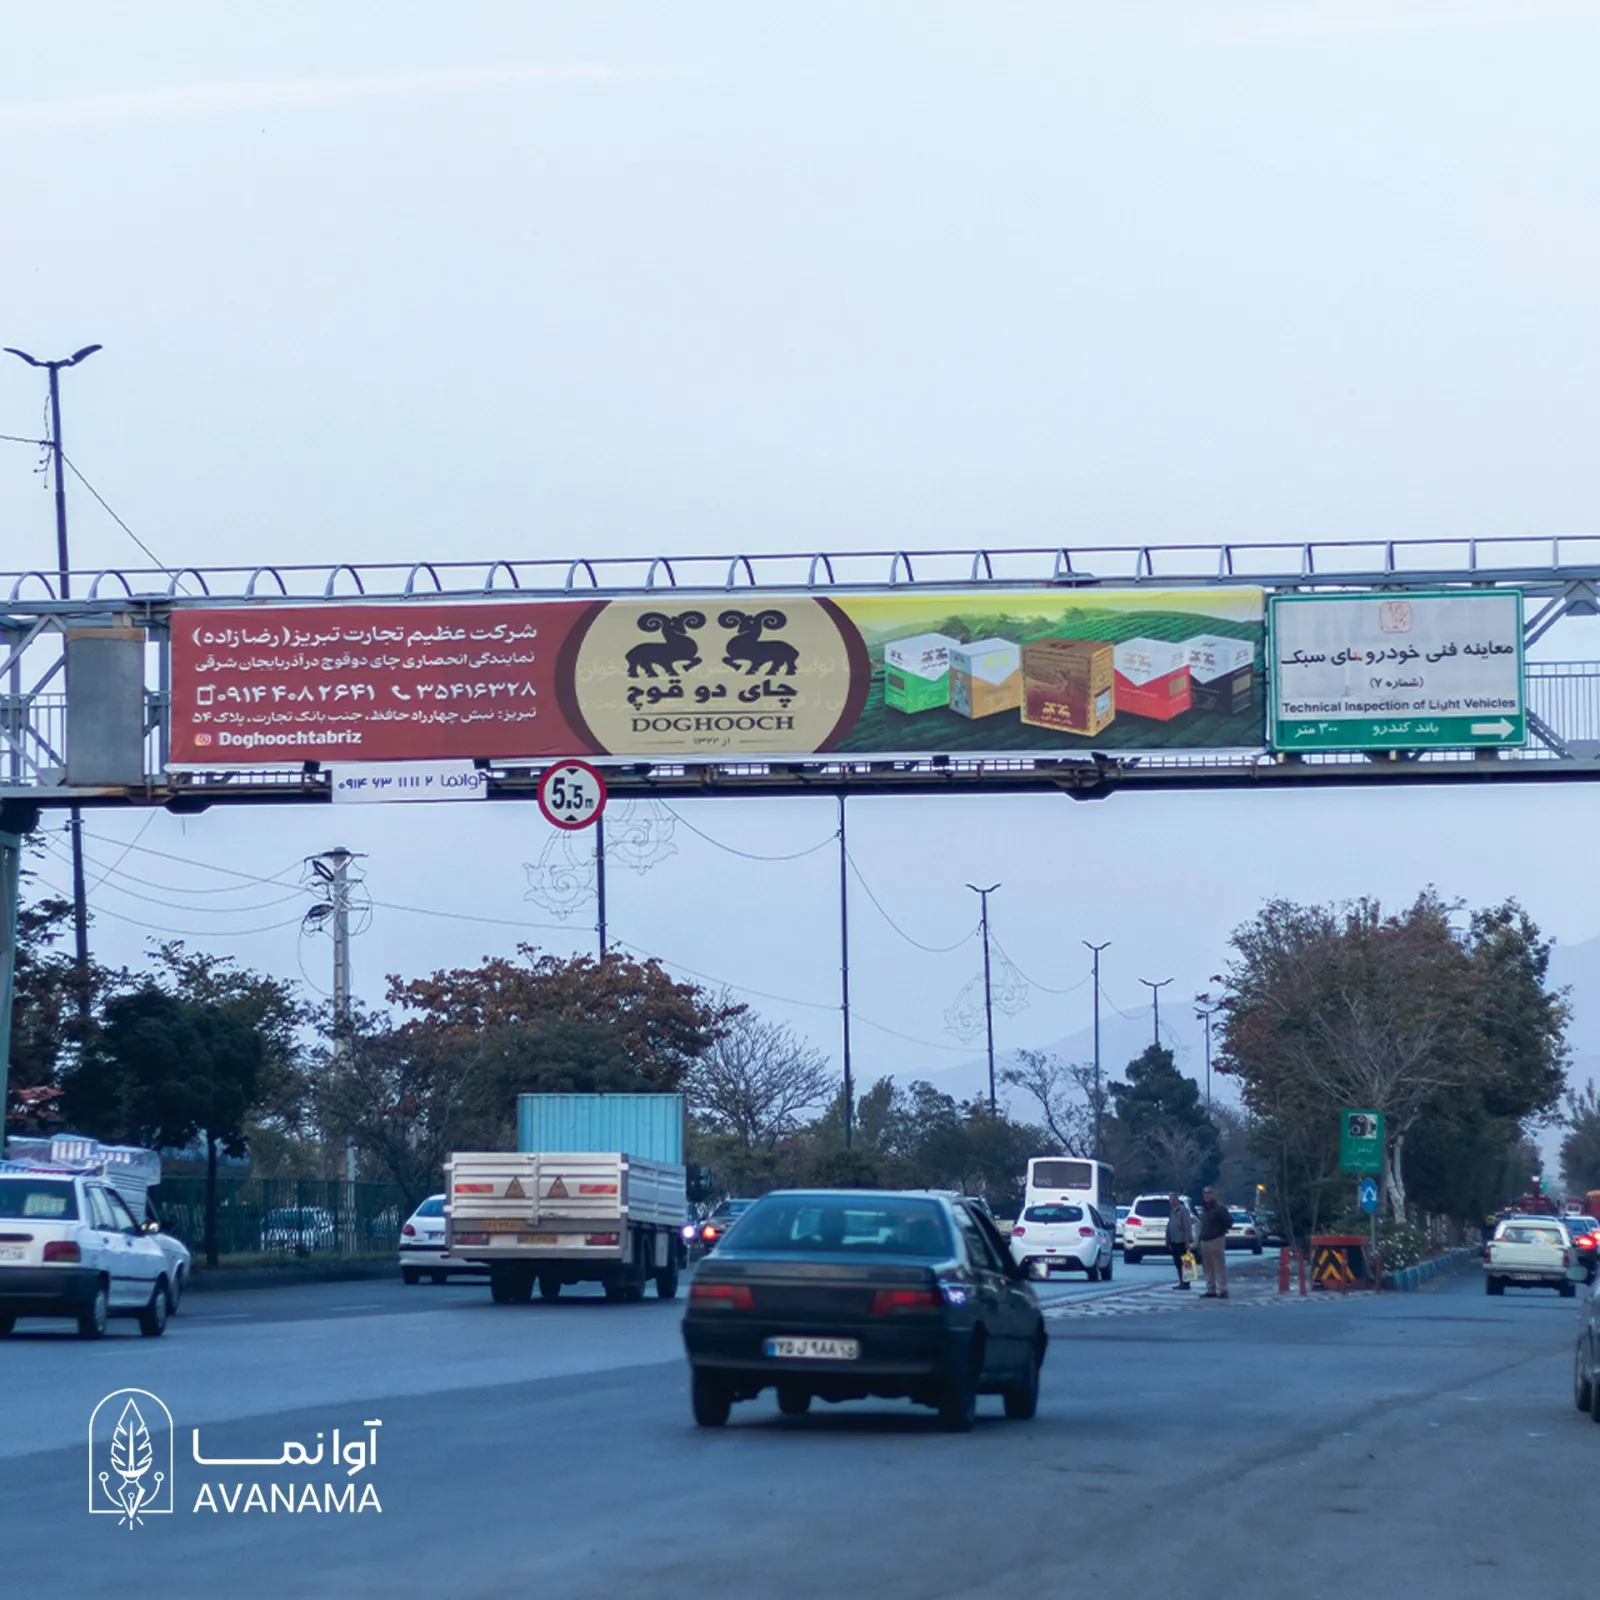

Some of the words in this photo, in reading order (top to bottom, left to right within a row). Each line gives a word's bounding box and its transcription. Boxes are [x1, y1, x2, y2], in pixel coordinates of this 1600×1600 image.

[343, 627, 404, 646] تجارت
[407, 625, 466, 647] عظیم
[470, 623, 537, 643] شرکت
[1426, 641, 1457, 662] فنی
[1463, 640, 1514, 659] معاینه
[195, 654, 237, 671] شرقی
[370, 654, 401, 671] چای
[402, 654, 468, 669] انحصاری
[468, 651, 535, 669] نمایندگی
[1281, 649, 1325, 668] سبک
[416, 681, 537, 700] ۳۵۴۱۶۳۲۸
[626, 678, 684, 711] قوچ
[694, 682, 727, 704] دو
[738, 679, 798, 709] چای
[1283, 700, 1342, 714] Technical
[1345, 699, 1410, 714] Inspection
[1413, 699, 1427, 710] of
[1464, 697, 1516, 710] Vehicles
[192, 711, 212, 723] ۵۴
[213, 711, 245, 727] پلاک
[294, 711, 326, 725] بانک
[327, 712, 363, 725] جنب
[411, 709, 459, 724] چهارراه
[460, 707, 495, 723] نبش
[631, 714, 795, 733] DOGHOOCH
[1294, 724, 1318, 738] متر
[1372, 721, 1412, 737] کندرو
[1415, 722, 1440, 736] باند
[219, 729, 362, 749] Doghoochtabriz
